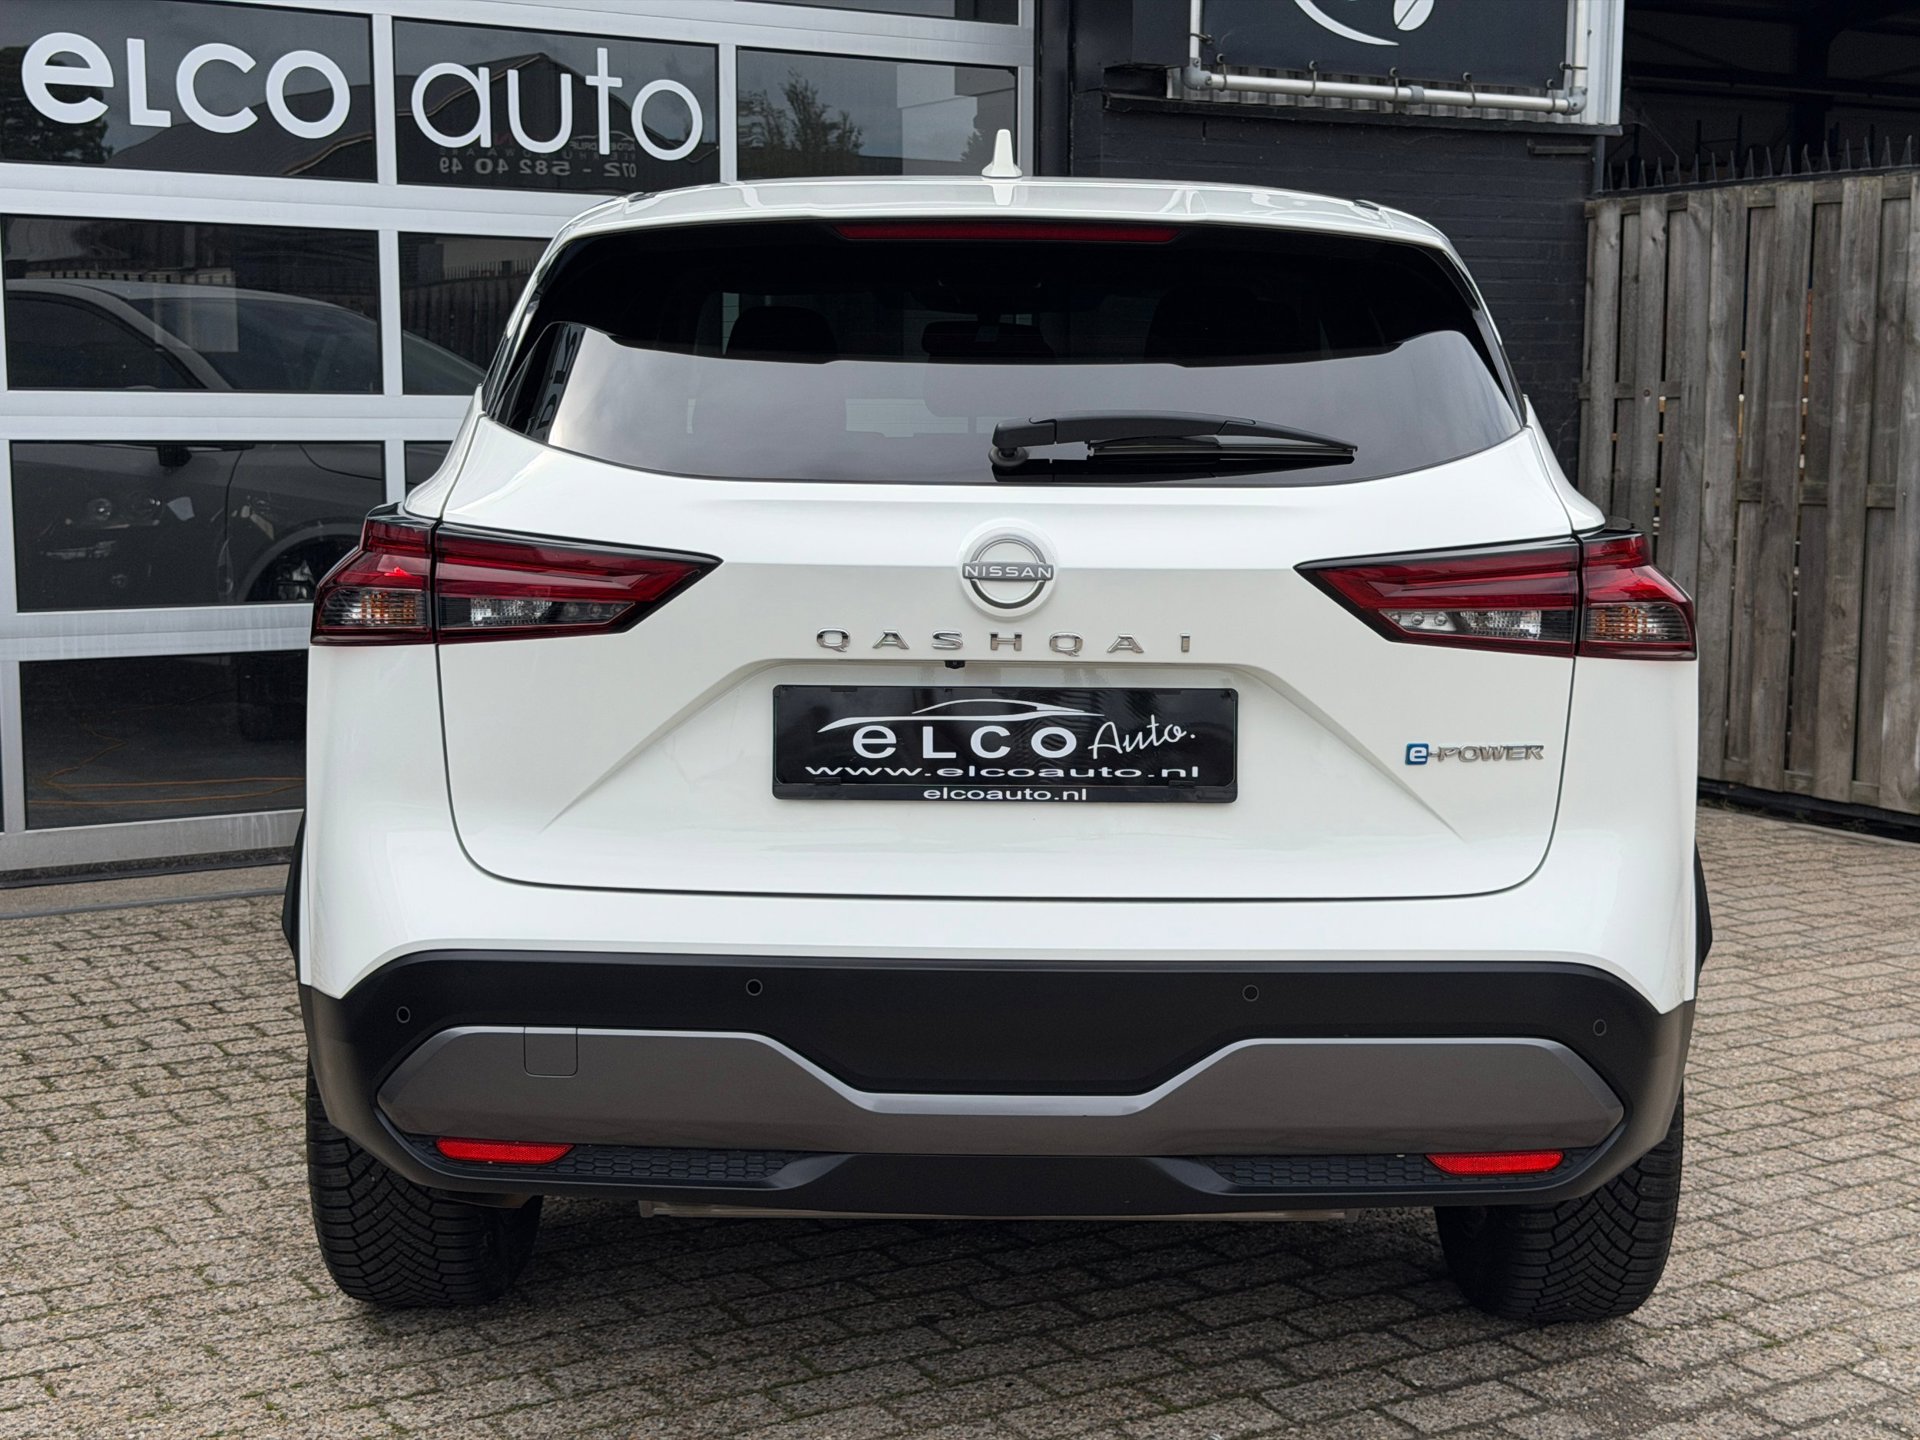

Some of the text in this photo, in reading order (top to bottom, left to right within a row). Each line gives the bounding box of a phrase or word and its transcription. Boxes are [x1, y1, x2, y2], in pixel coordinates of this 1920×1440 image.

[411, 47, 703, 161] auto
[964, 565, 1052, 578] NISSAN
[816, 627, 1192, 657] QASHQAI
[1405, 743, 1544, 765] e-POWER
[805, 765, 1199, 778] www.elcoauto.nl
[923, 786, 1087, 801] elcoauto.nl
